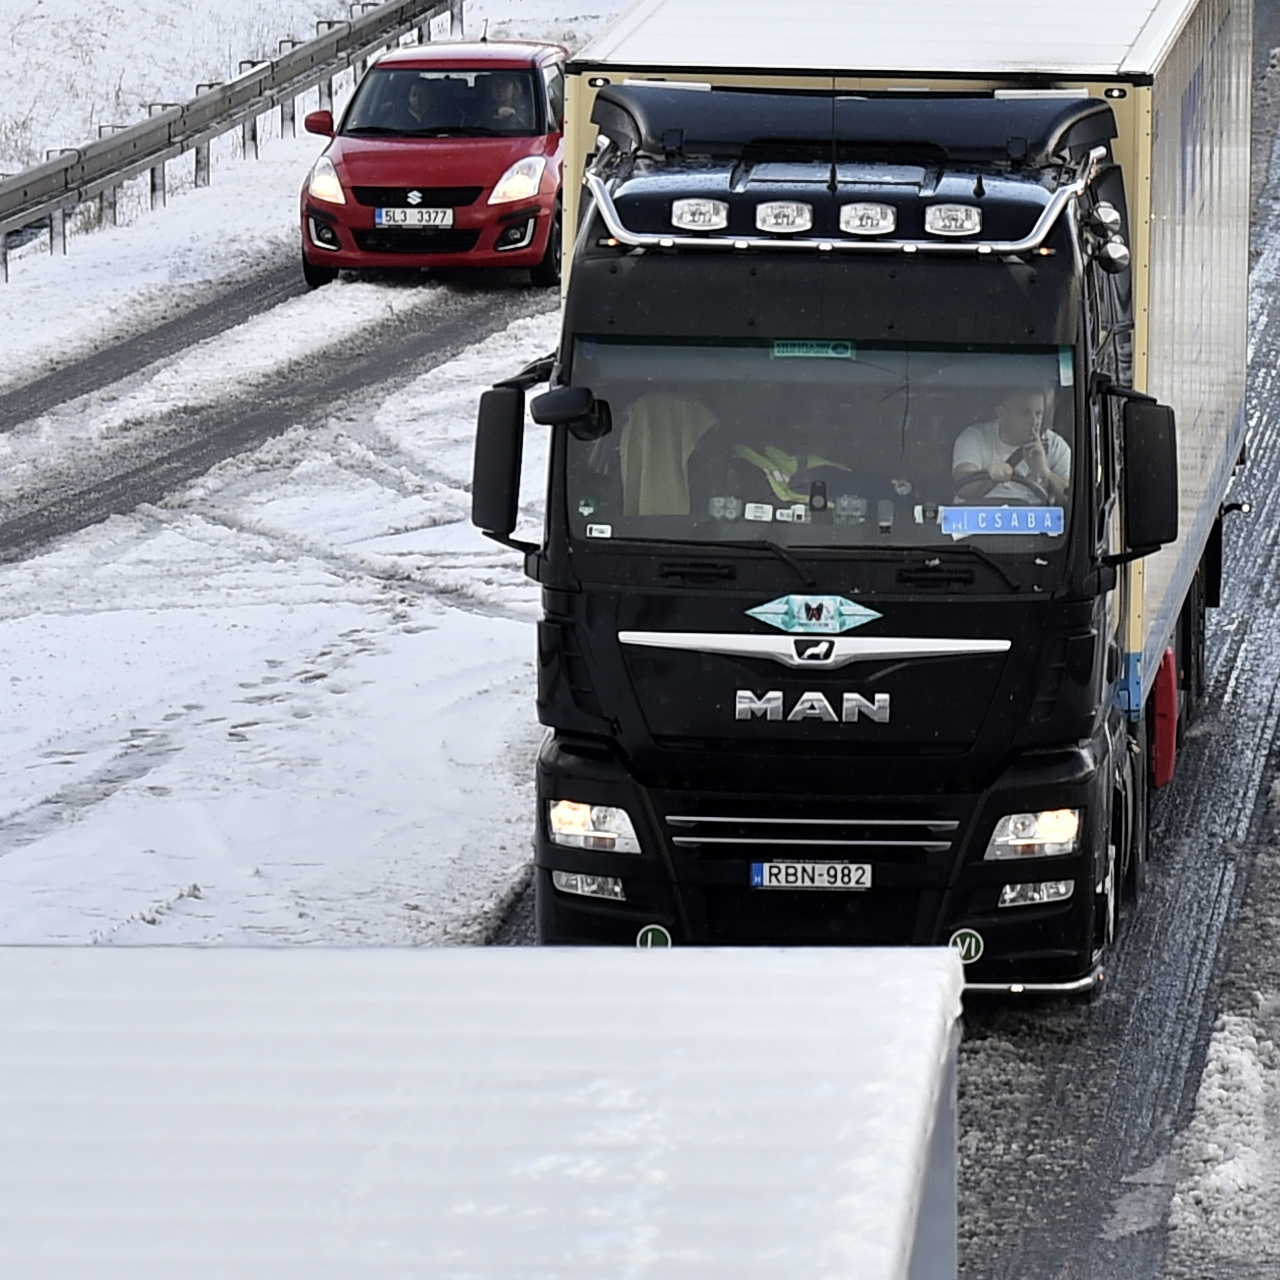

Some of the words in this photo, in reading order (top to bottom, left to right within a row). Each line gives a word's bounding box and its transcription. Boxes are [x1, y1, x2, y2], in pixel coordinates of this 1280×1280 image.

[384, 209, 408, 223] 5L3
[416, 210, 448, 224] 3377
[978, 512, 1053, 528] CSABA
[735, 689, 890, 723] MAN
[768, 864, 867, 886] RBN-982
